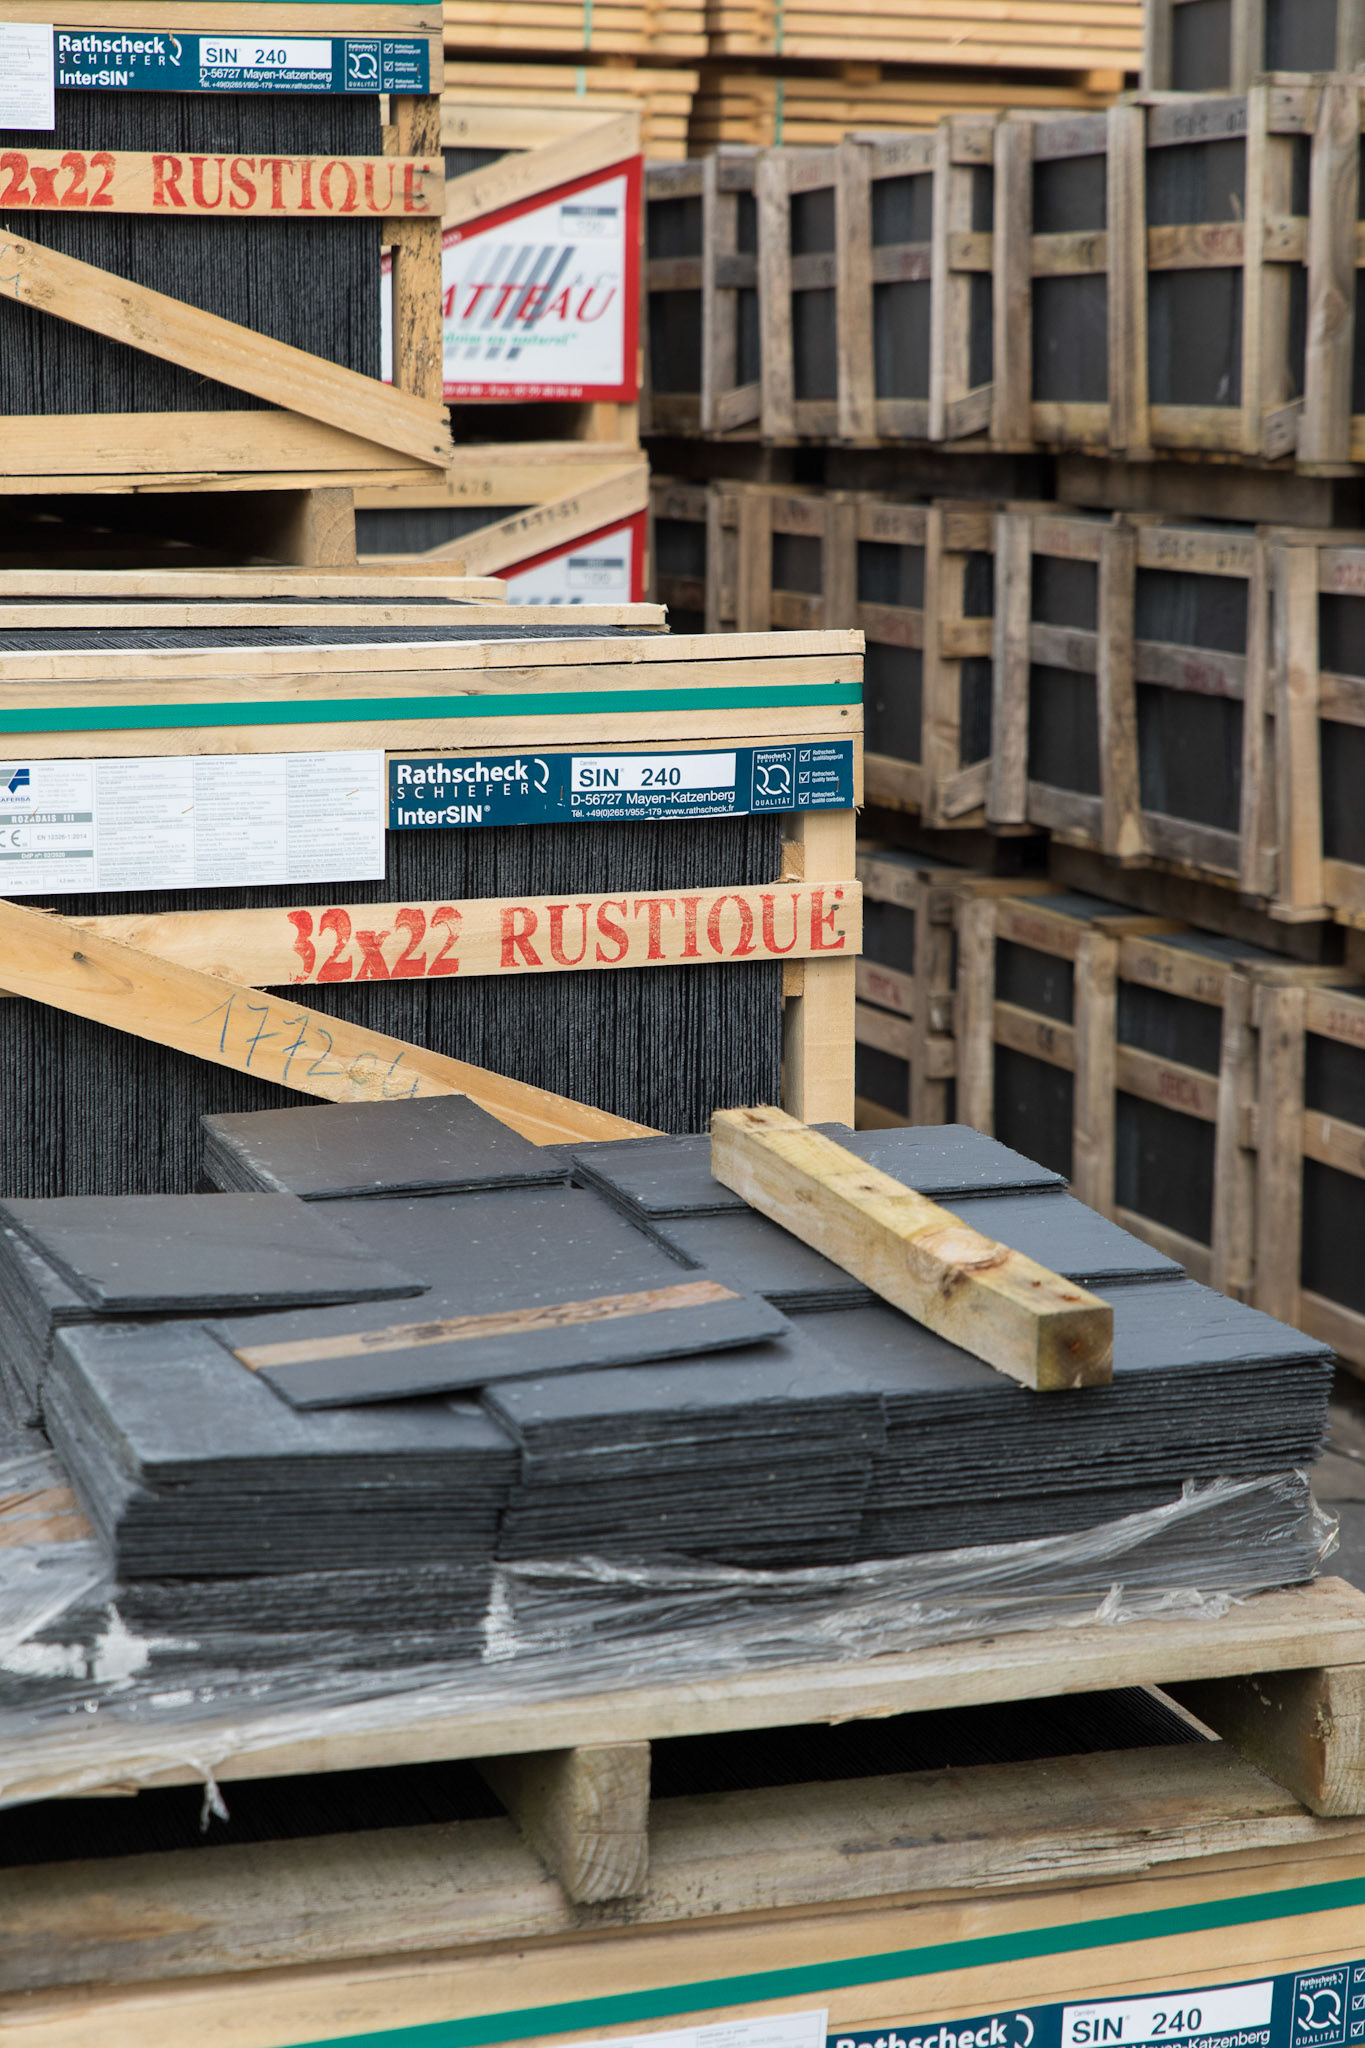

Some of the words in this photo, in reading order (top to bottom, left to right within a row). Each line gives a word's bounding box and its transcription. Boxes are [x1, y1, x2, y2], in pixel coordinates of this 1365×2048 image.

[58, 34, 166, 54] Rathscheck
[59, 53, 166, 66] SCHIEFER
[255, 49, 288, 65] 240
[199, 68, 241, 79] D-56727
[243, 69, 333, 82] Mayen-Katzenberg
[152, 154, 432, 214] RUSTIQUE
[397, 760, 529, 785] Rathscheck
[640, 766, 682, 787] 240
[397, 782, 529, 800] SCHIEFER
[571, 793, 623, 806] D-56727
[625, 790, 736, 807] Mayen-Katzenberg
[499, 888, 847, 968] RUSTIQUE
[1150, 2008, 1202, 2036] 240
[1295, 2029, 1341, 2047] QUALITÄT
